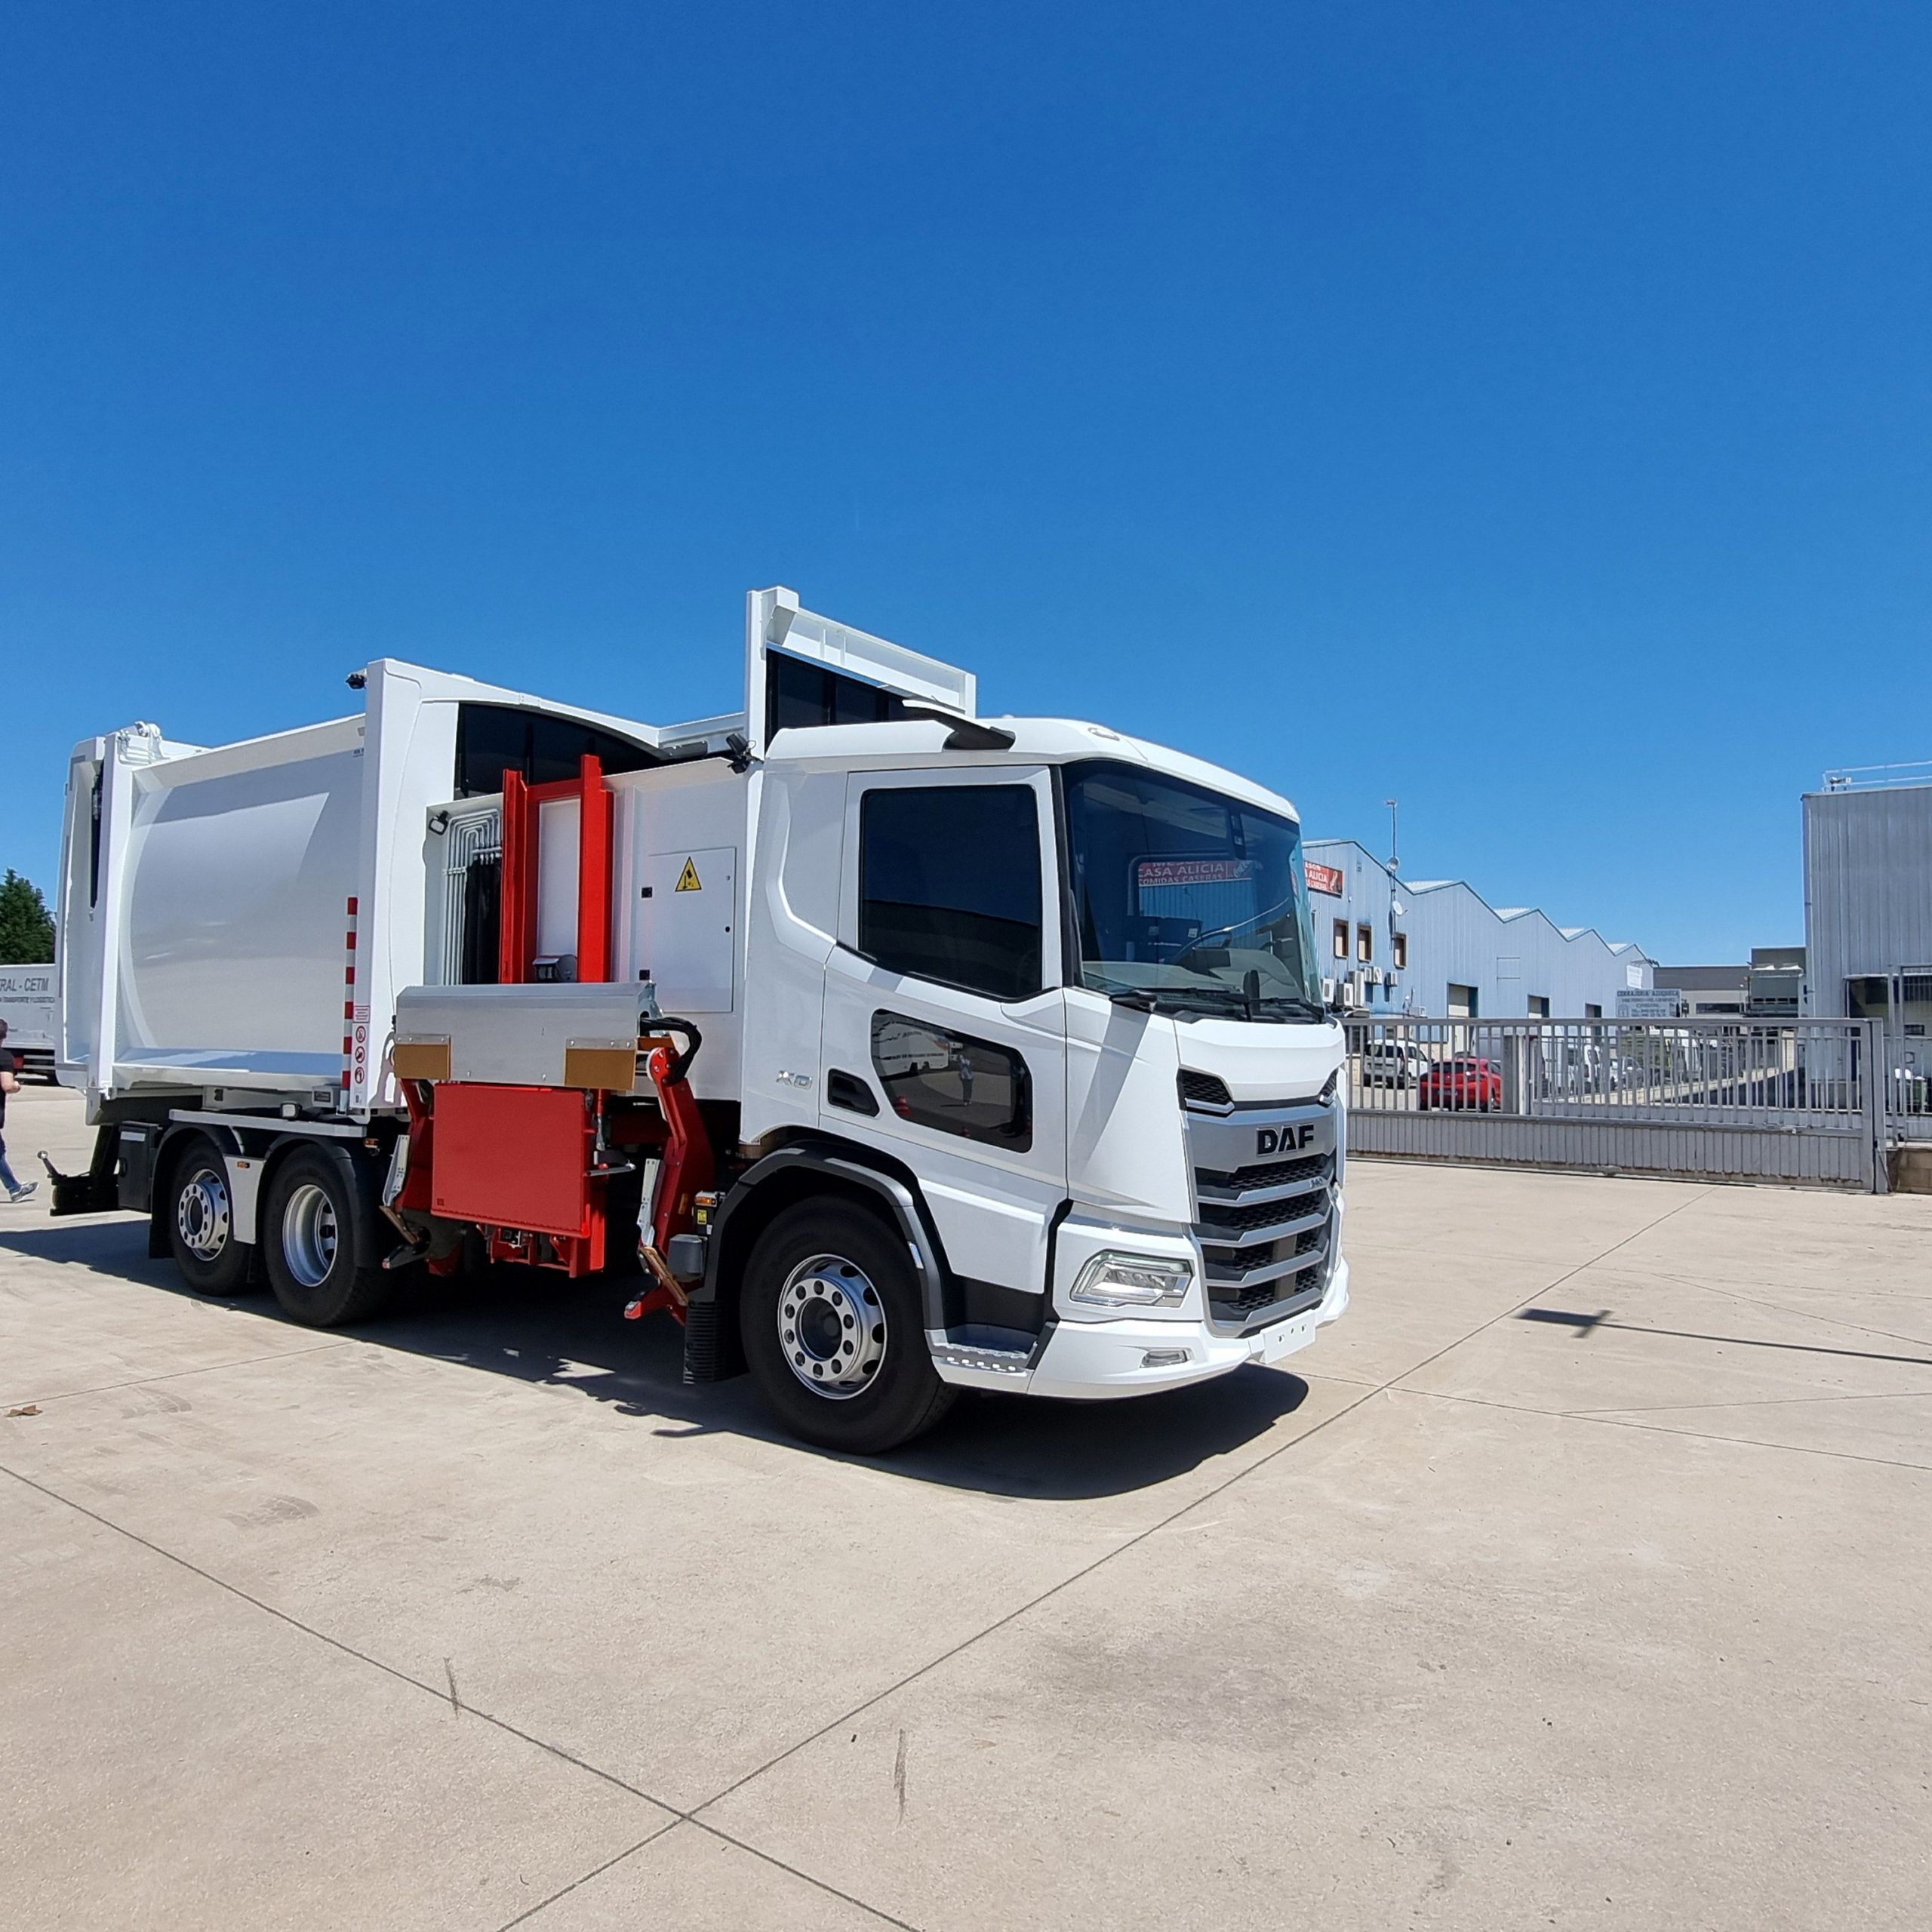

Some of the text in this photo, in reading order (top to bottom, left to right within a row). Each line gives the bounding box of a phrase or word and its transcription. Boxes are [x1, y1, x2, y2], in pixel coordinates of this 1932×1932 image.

[1138, 863, 1224, 877] CASA ALICIA
[1182, 873, 1223, 882] CASERAS
[0, 978, 17, 992] RAL
[776, 1070, 813, 1090] XD
[1257, 1124, 1314, 1154] DAF
